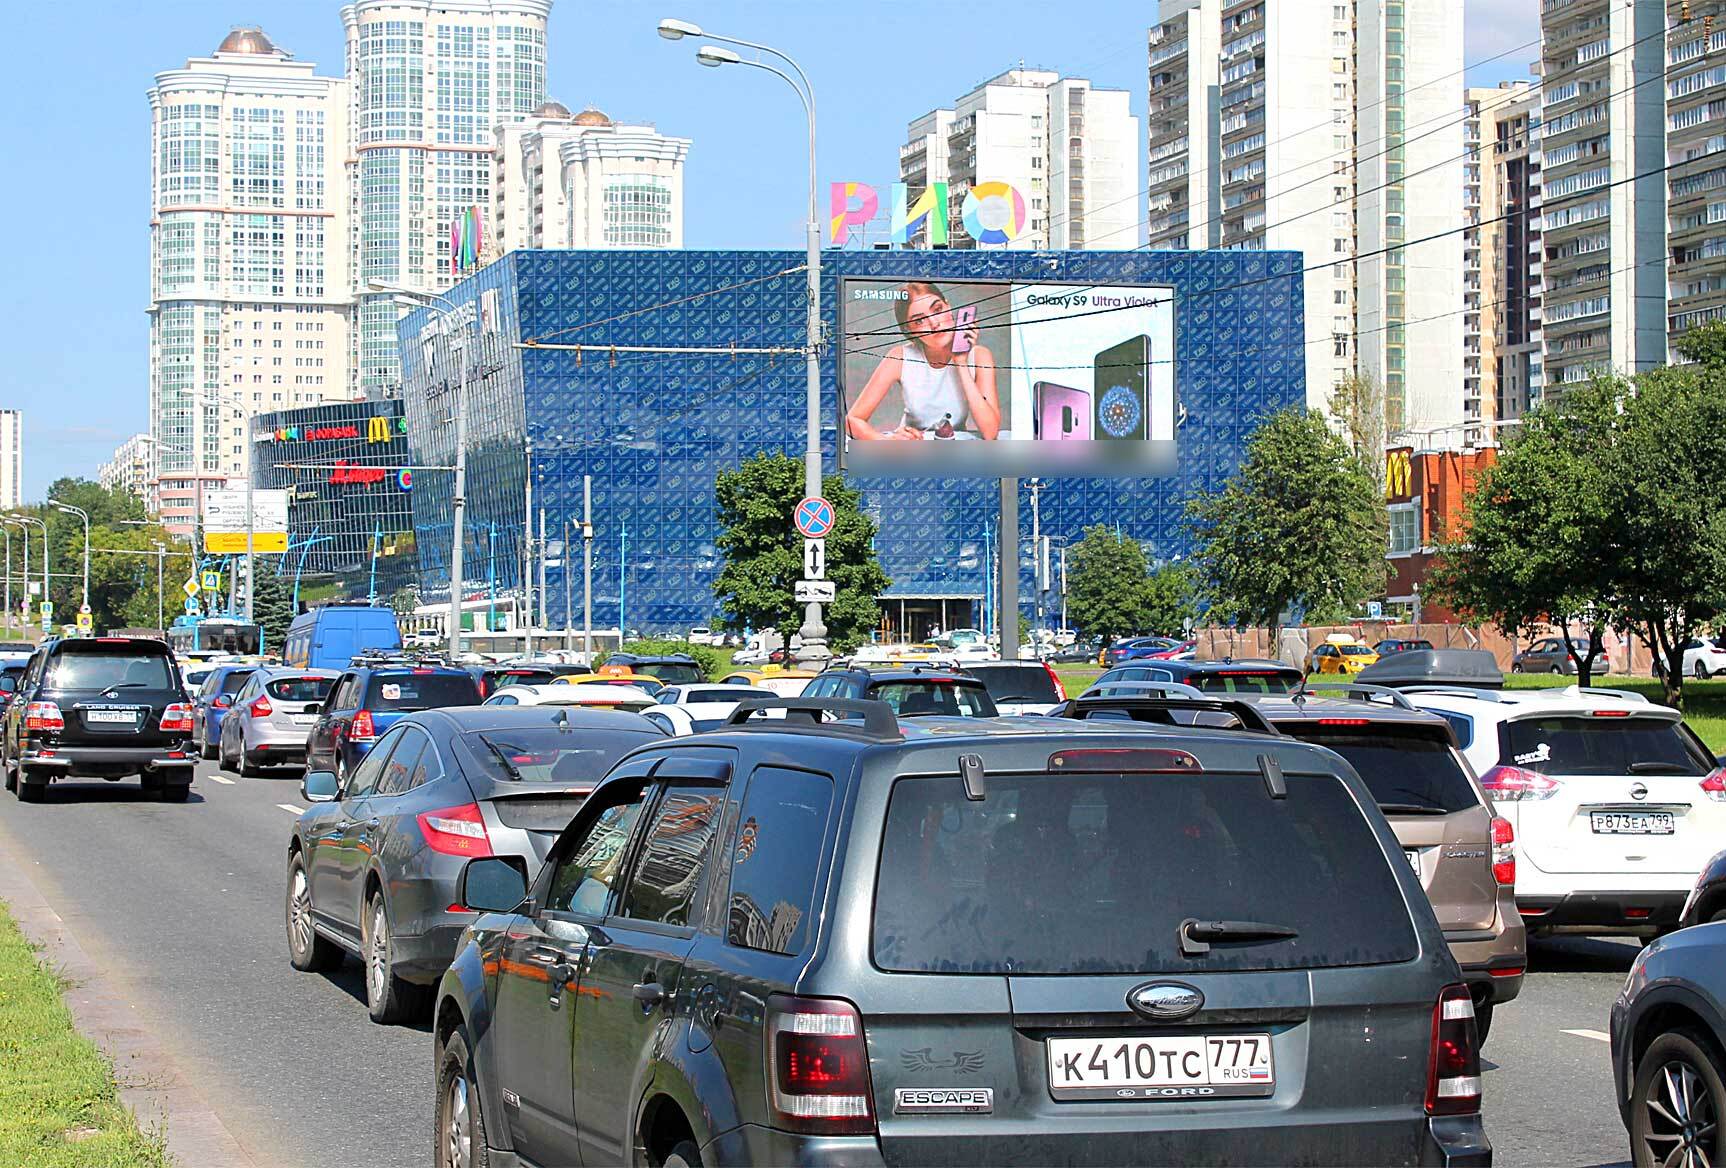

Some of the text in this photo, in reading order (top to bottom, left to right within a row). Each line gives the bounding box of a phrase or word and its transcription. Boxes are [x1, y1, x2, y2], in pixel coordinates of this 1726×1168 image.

[830, 181, 1026, 245] РИО
[854, 289, 909, 300] SAMSUNG
[1027, 294, 1158, 309] Galaxy S9 Ultra Violet
[1649, 814, 1669, 825] 799
[1209, 1039, 1259, 1067] 777
[1223, 1068, 1249, 1079] RUS
[1145, 1087, 1216, 1096] FORD
[903, 1092, 985, 1104] ESCAPE
